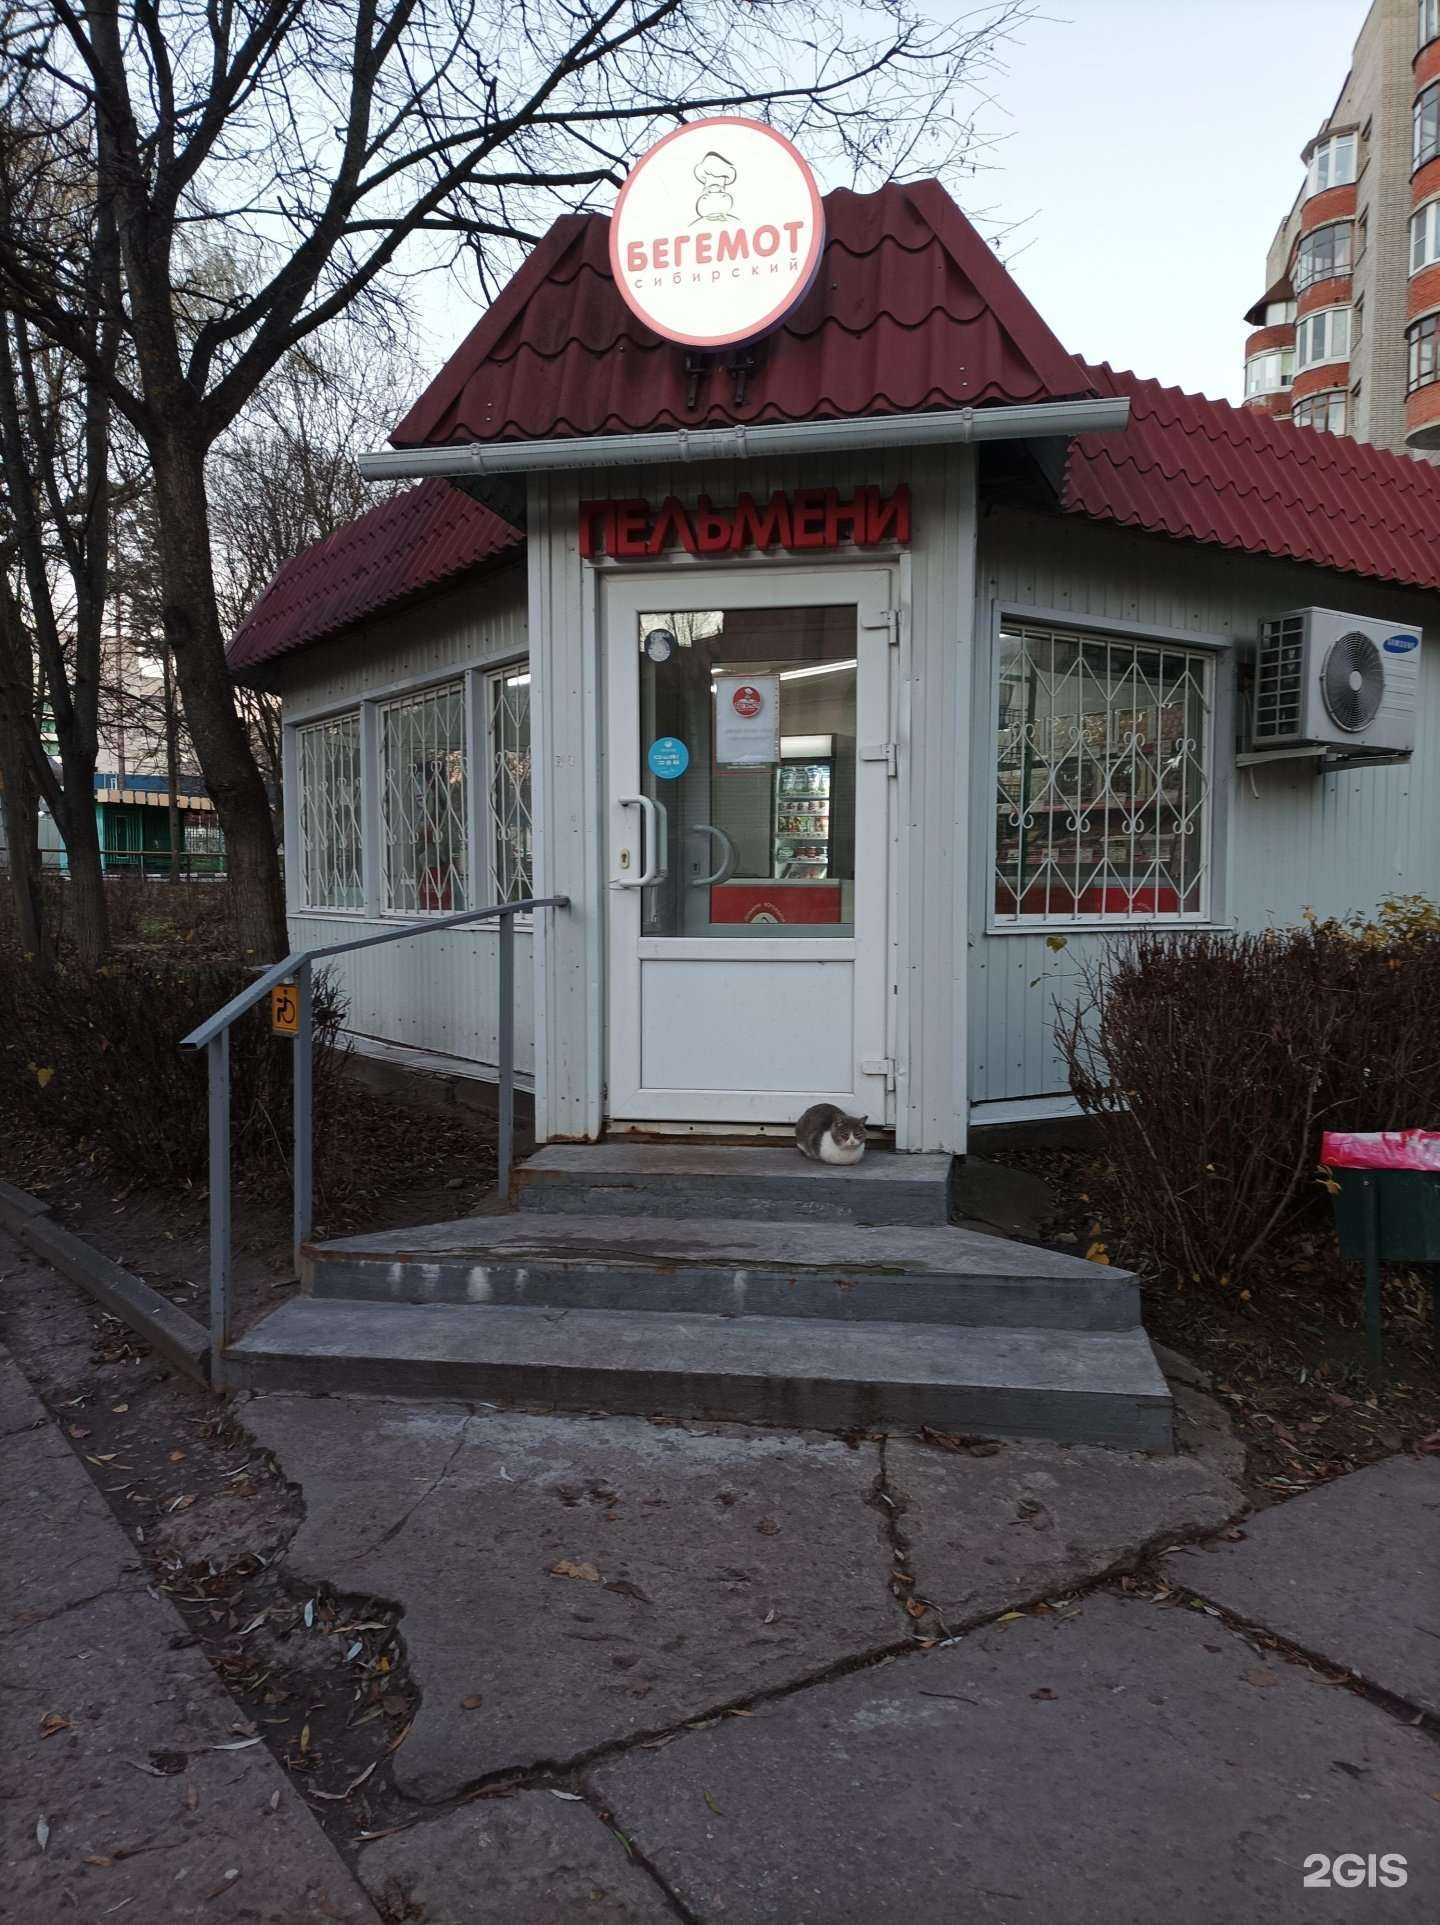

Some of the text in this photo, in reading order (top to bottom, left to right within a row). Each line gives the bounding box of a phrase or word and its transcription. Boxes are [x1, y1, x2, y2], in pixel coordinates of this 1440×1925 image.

[627, 221, 804, 272] БЕГЕМОТ
[634, 258, 798, 289] сибирский
[579, 483, 911, 559] ПЕЛЬМЕНИ
